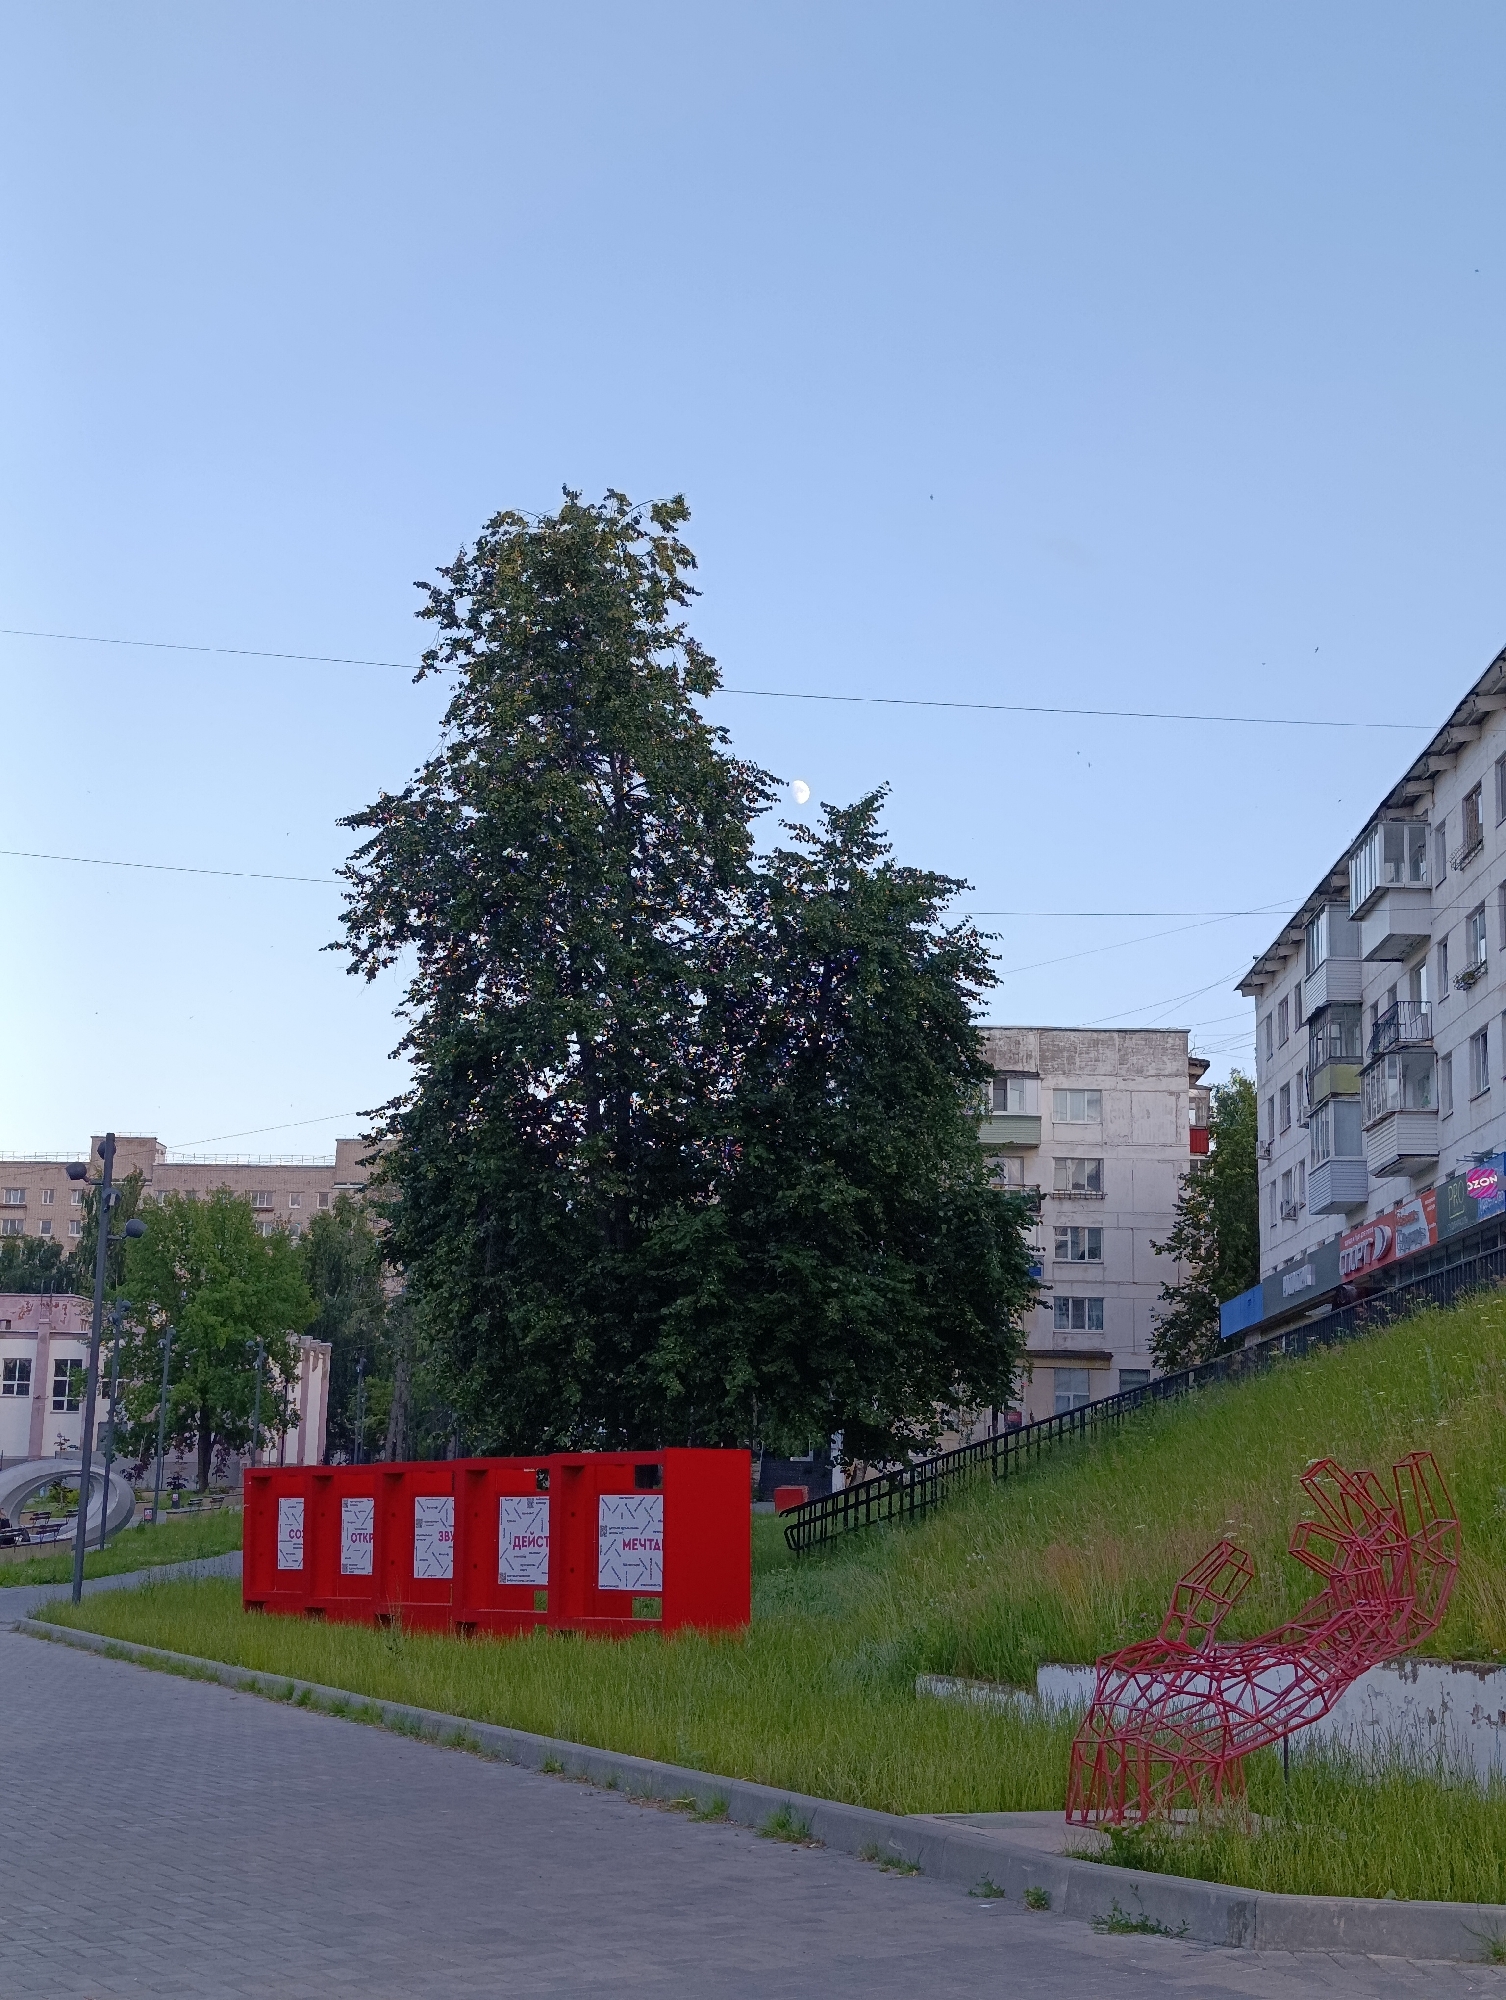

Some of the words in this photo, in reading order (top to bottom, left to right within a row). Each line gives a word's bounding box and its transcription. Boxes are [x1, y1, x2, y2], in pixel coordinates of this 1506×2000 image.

[1467, 1174, 1498, 1191] OZON
[289, 1529, 304, 1540] СО
[512, 1530, 550, 1551] ДЕЙСТ
[622, 1537, 664, 1551] МЕЧТА
